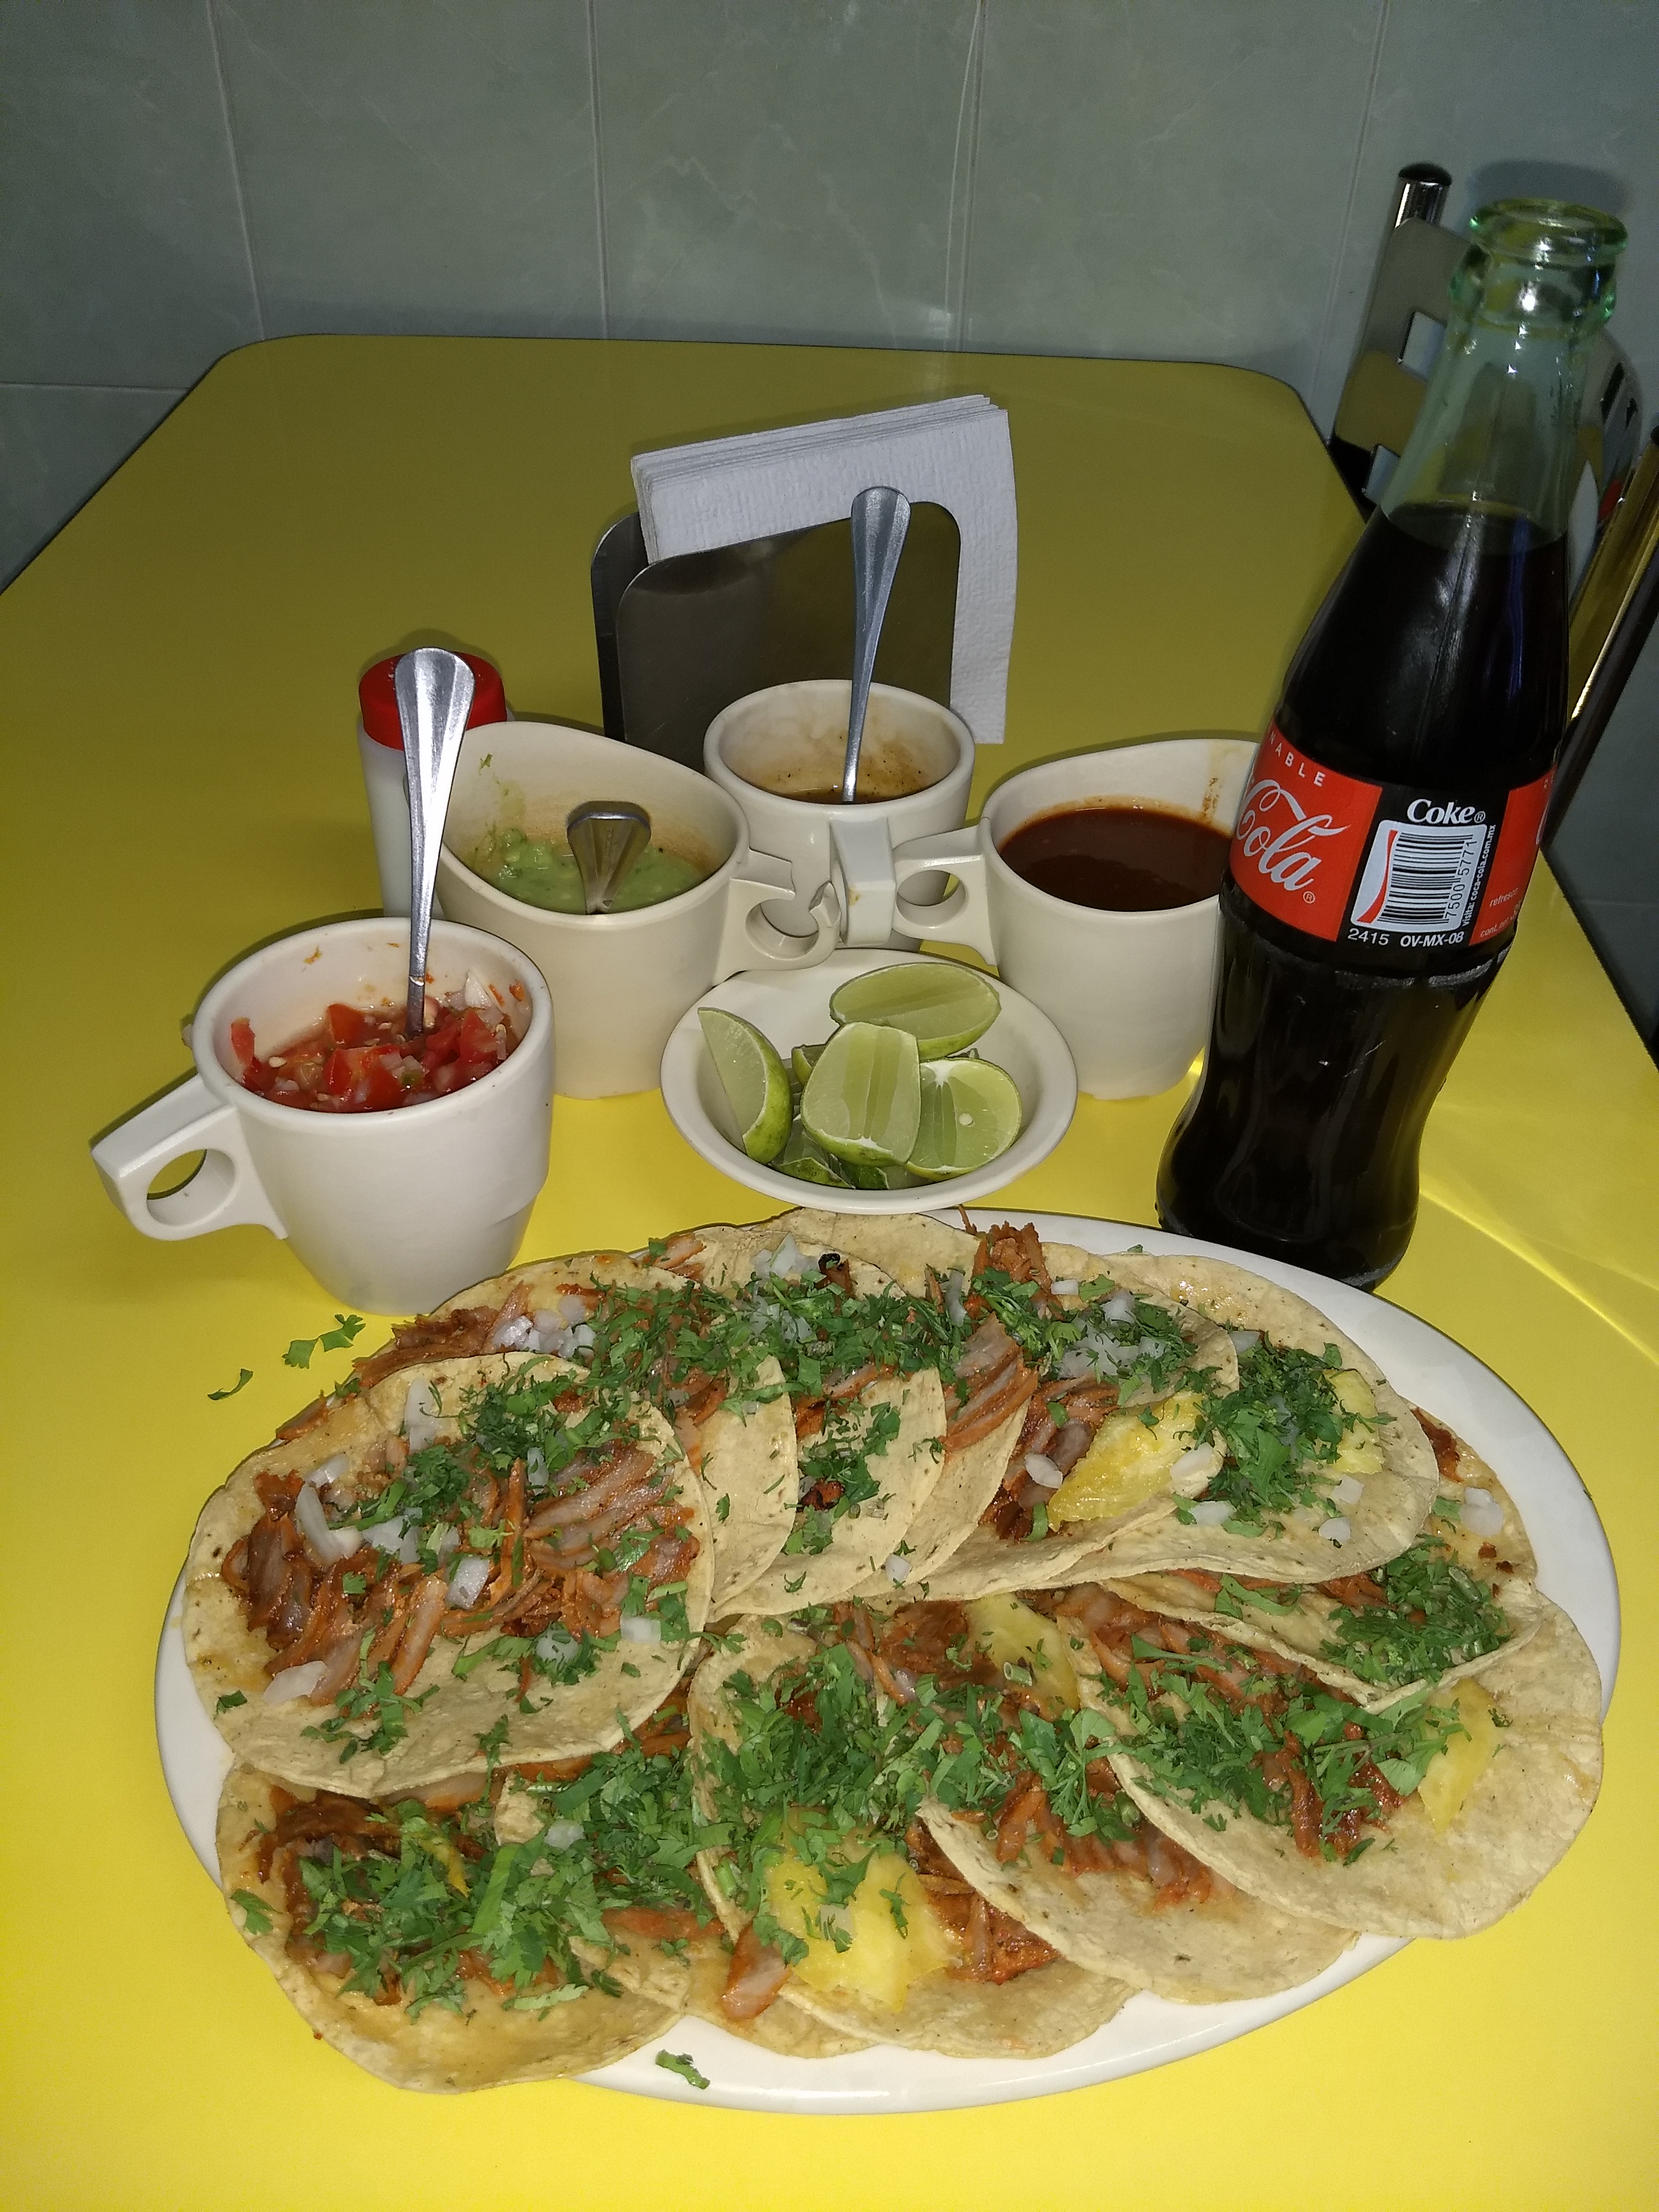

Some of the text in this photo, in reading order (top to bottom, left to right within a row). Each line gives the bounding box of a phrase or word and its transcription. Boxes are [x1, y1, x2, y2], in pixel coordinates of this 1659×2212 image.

[1237, 779, 1352, 891] Cola
[1407, 798, 1476, 824] Coke
[1444, 839, 1477, 919] 7500 5771
[1470, 824, 1497, 901] coca-cola.com.mx
[1347, 928, 1465, 947] 2415 OV-MX-08
